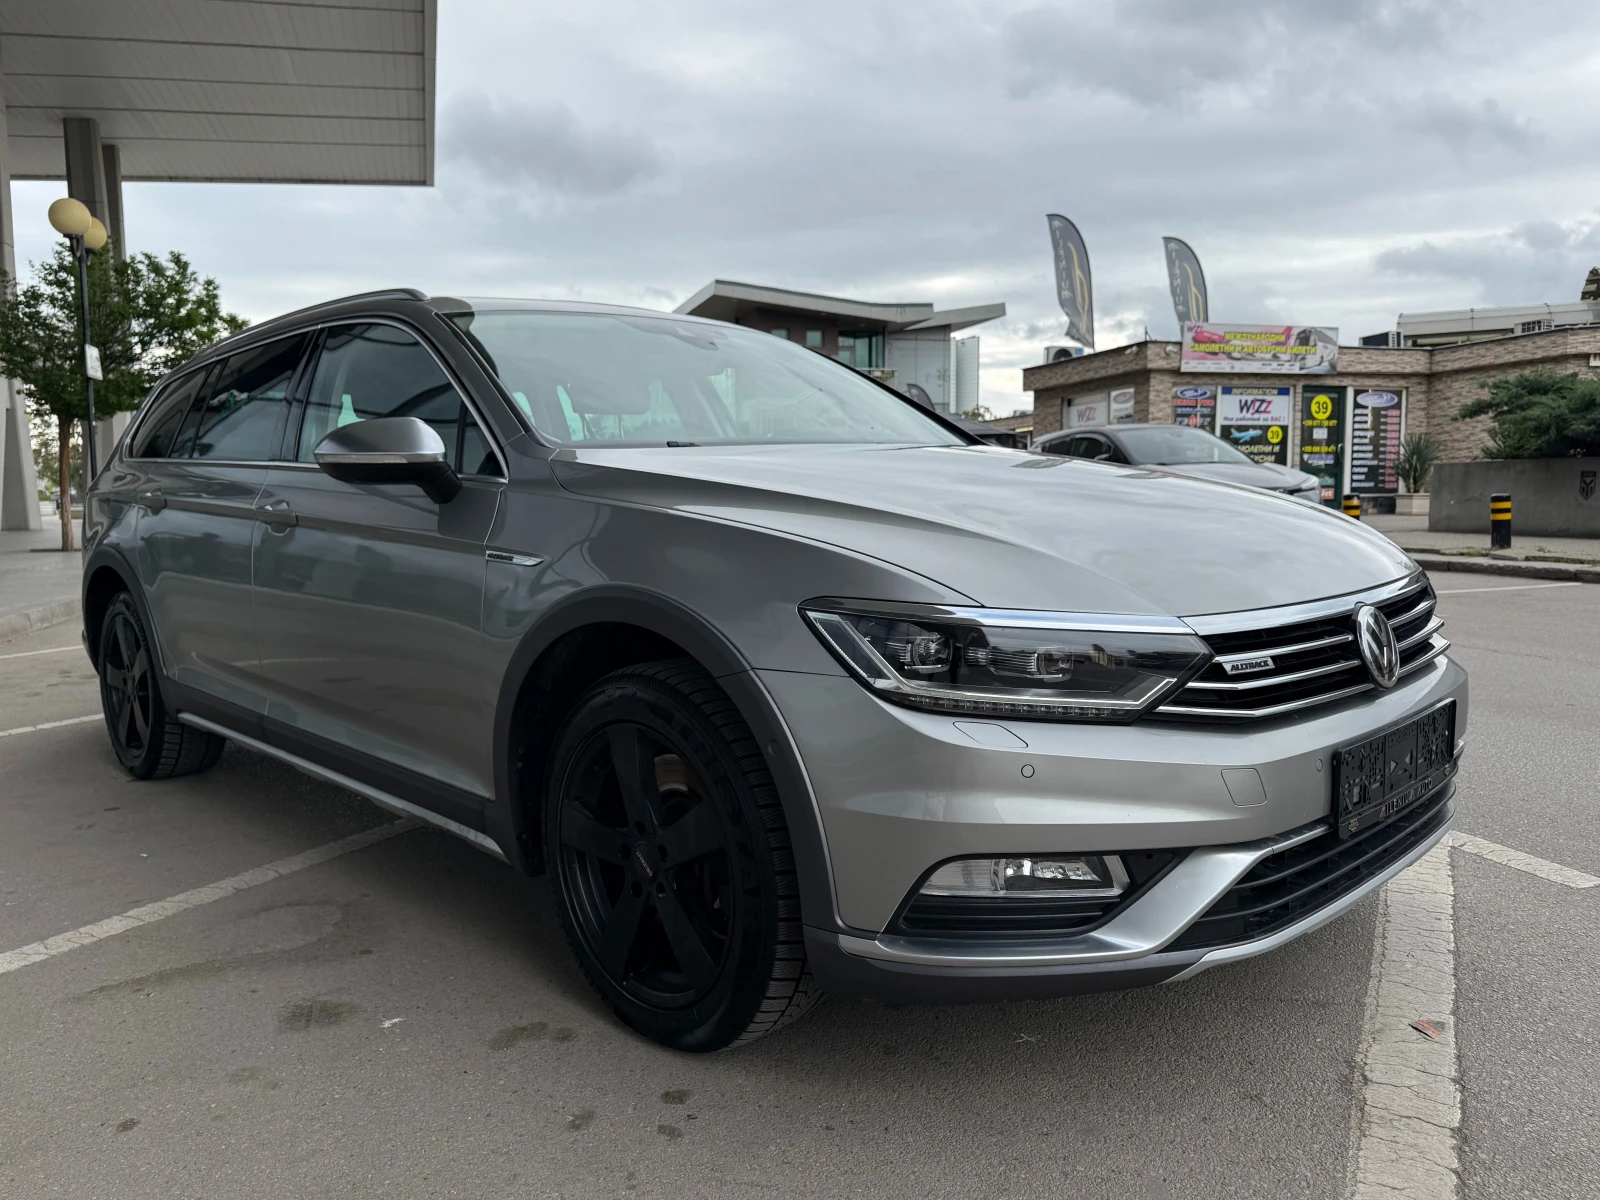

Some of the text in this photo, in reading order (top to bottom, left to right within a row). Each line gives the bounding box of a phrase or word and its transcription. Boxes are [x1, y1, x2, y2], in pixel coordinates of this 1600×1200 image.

[1224, 332, 1286, 342] МЕЖДУНАРОДНИ
[1189, 344, 1235, 353] САМОЛЕТНИ
[1243, 345, 1286, 354] АВТОБУСНИ
[1287, 345, 1317, 355] БИЛЕТИ
[1315, 402, 1328, 414] 39
[1269, 430, 1280, 440] 39
[1236, 444, 1280, 453] МОЛЕТНИ И
[1231, 659, 1269, 672] ALLTRACK
[1417, 778, 1433, 796] AUTO
